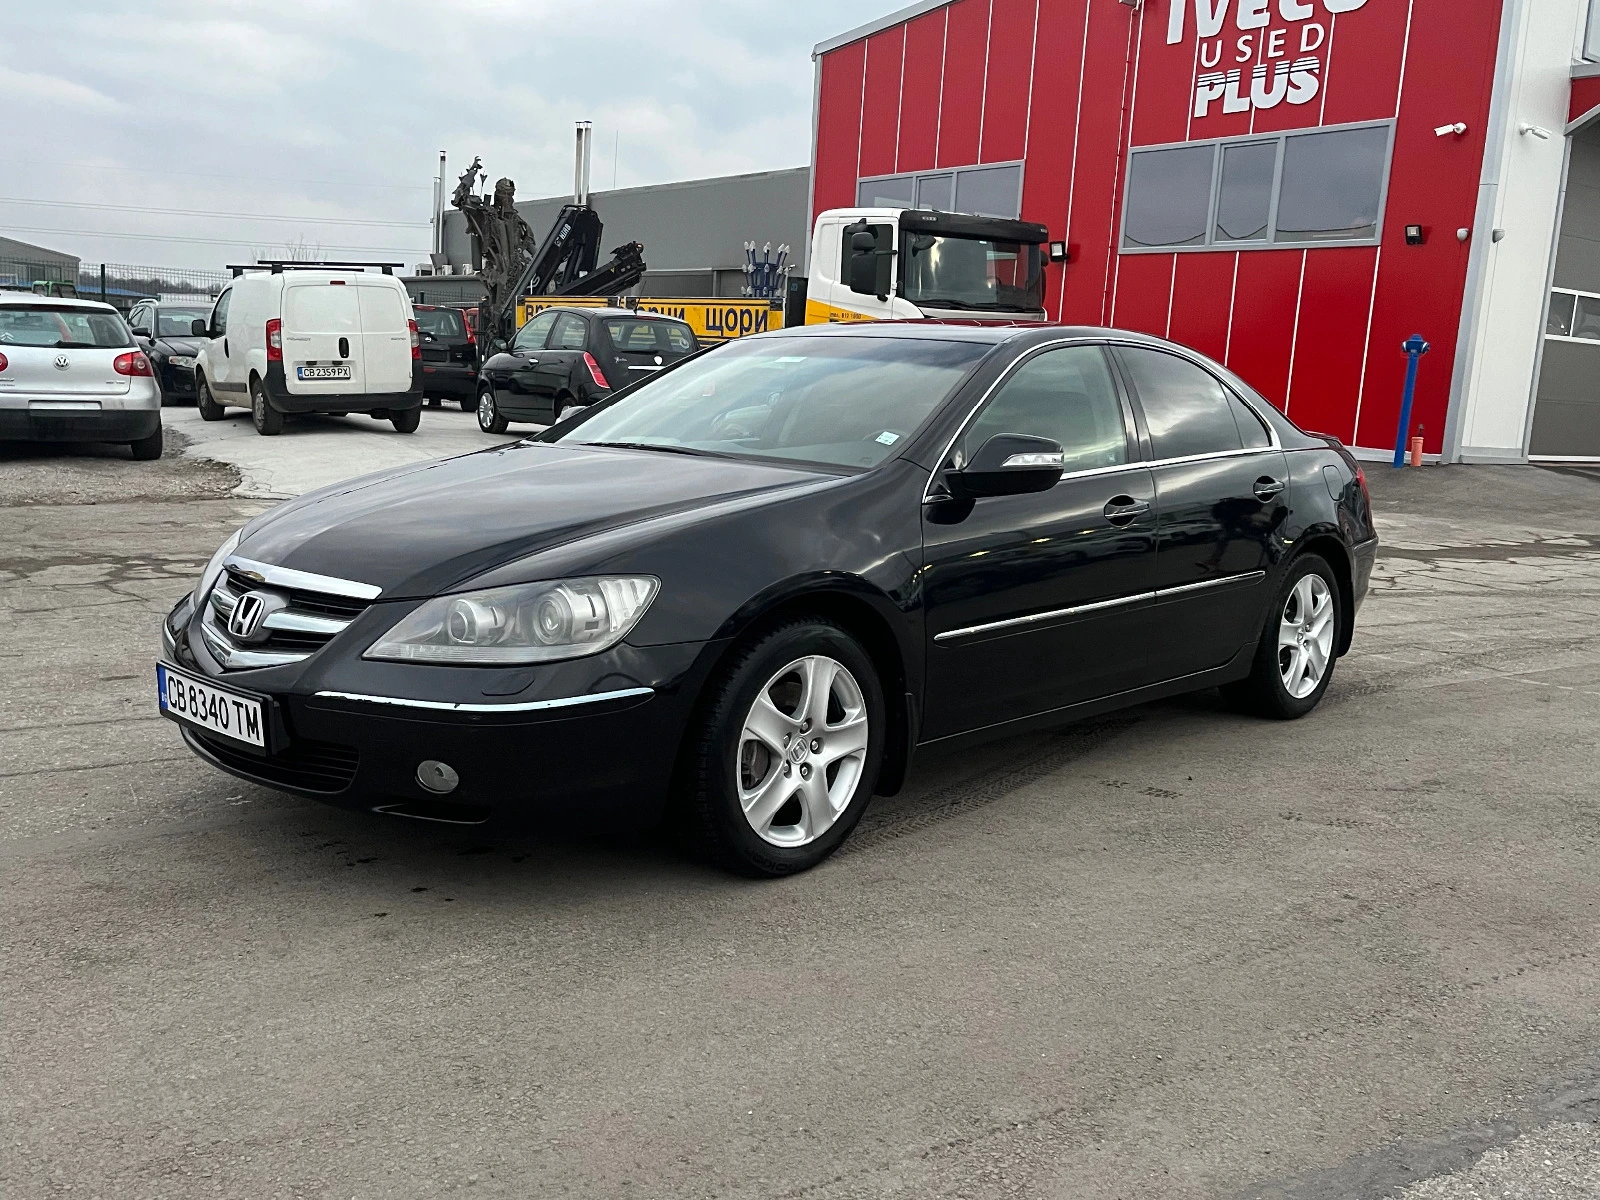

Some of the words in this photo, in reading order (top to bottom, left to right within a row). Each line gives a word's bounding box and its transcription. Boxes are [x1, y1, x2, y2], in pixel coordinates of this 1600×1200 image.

[1167, 0, 1369, 45] IVE
[1200, 23, 1326, 68] USED
[1194, 56, 1321, 118] PLUS
[316, 368, 336, 377] 2359
[337, 367, 349, 377] PX
[168, 675, 187, 713] CB
[188, 685, 230, 730] 8340
[231, 699, 260, 741] TM
